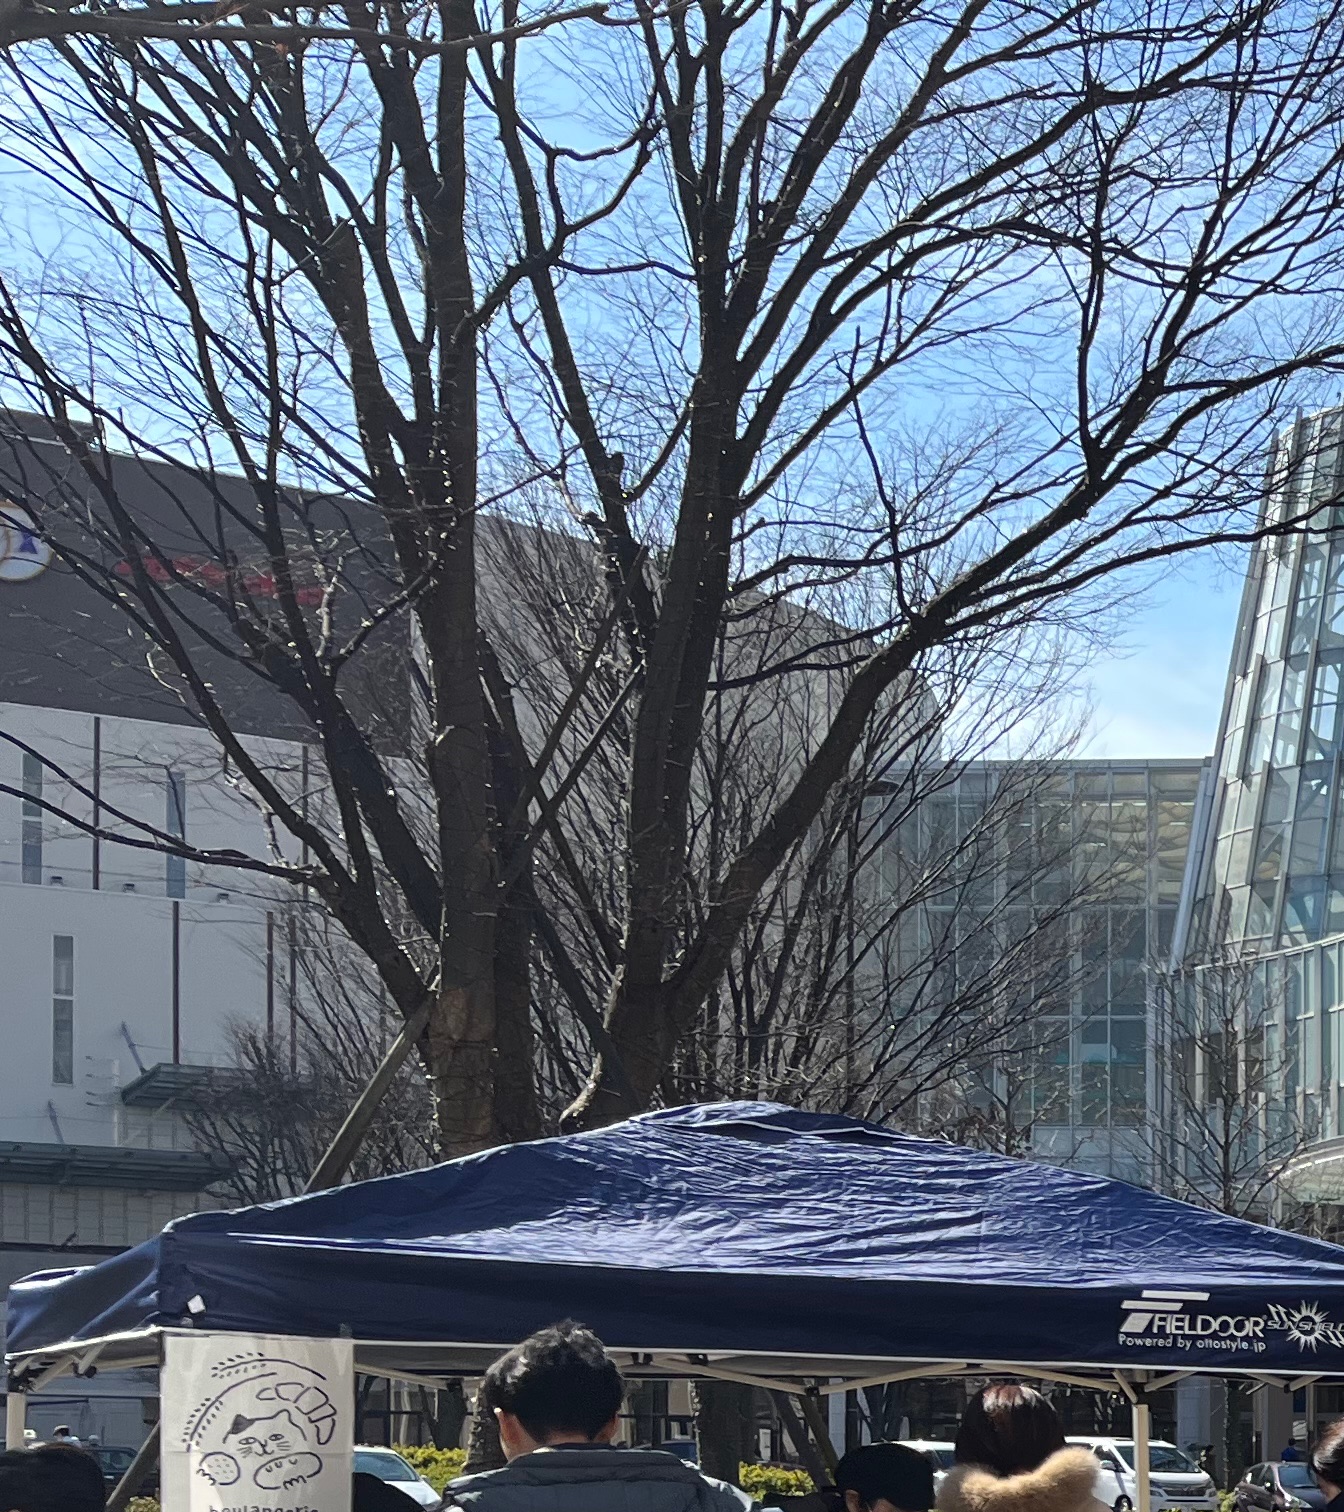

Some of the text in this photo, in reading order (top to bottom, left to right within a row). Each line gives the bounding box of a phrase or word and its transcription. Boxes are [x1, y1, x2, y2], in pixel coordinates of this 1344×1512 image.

[1118, 1333, 1266, 1353] Powered by ottostyle.jp
